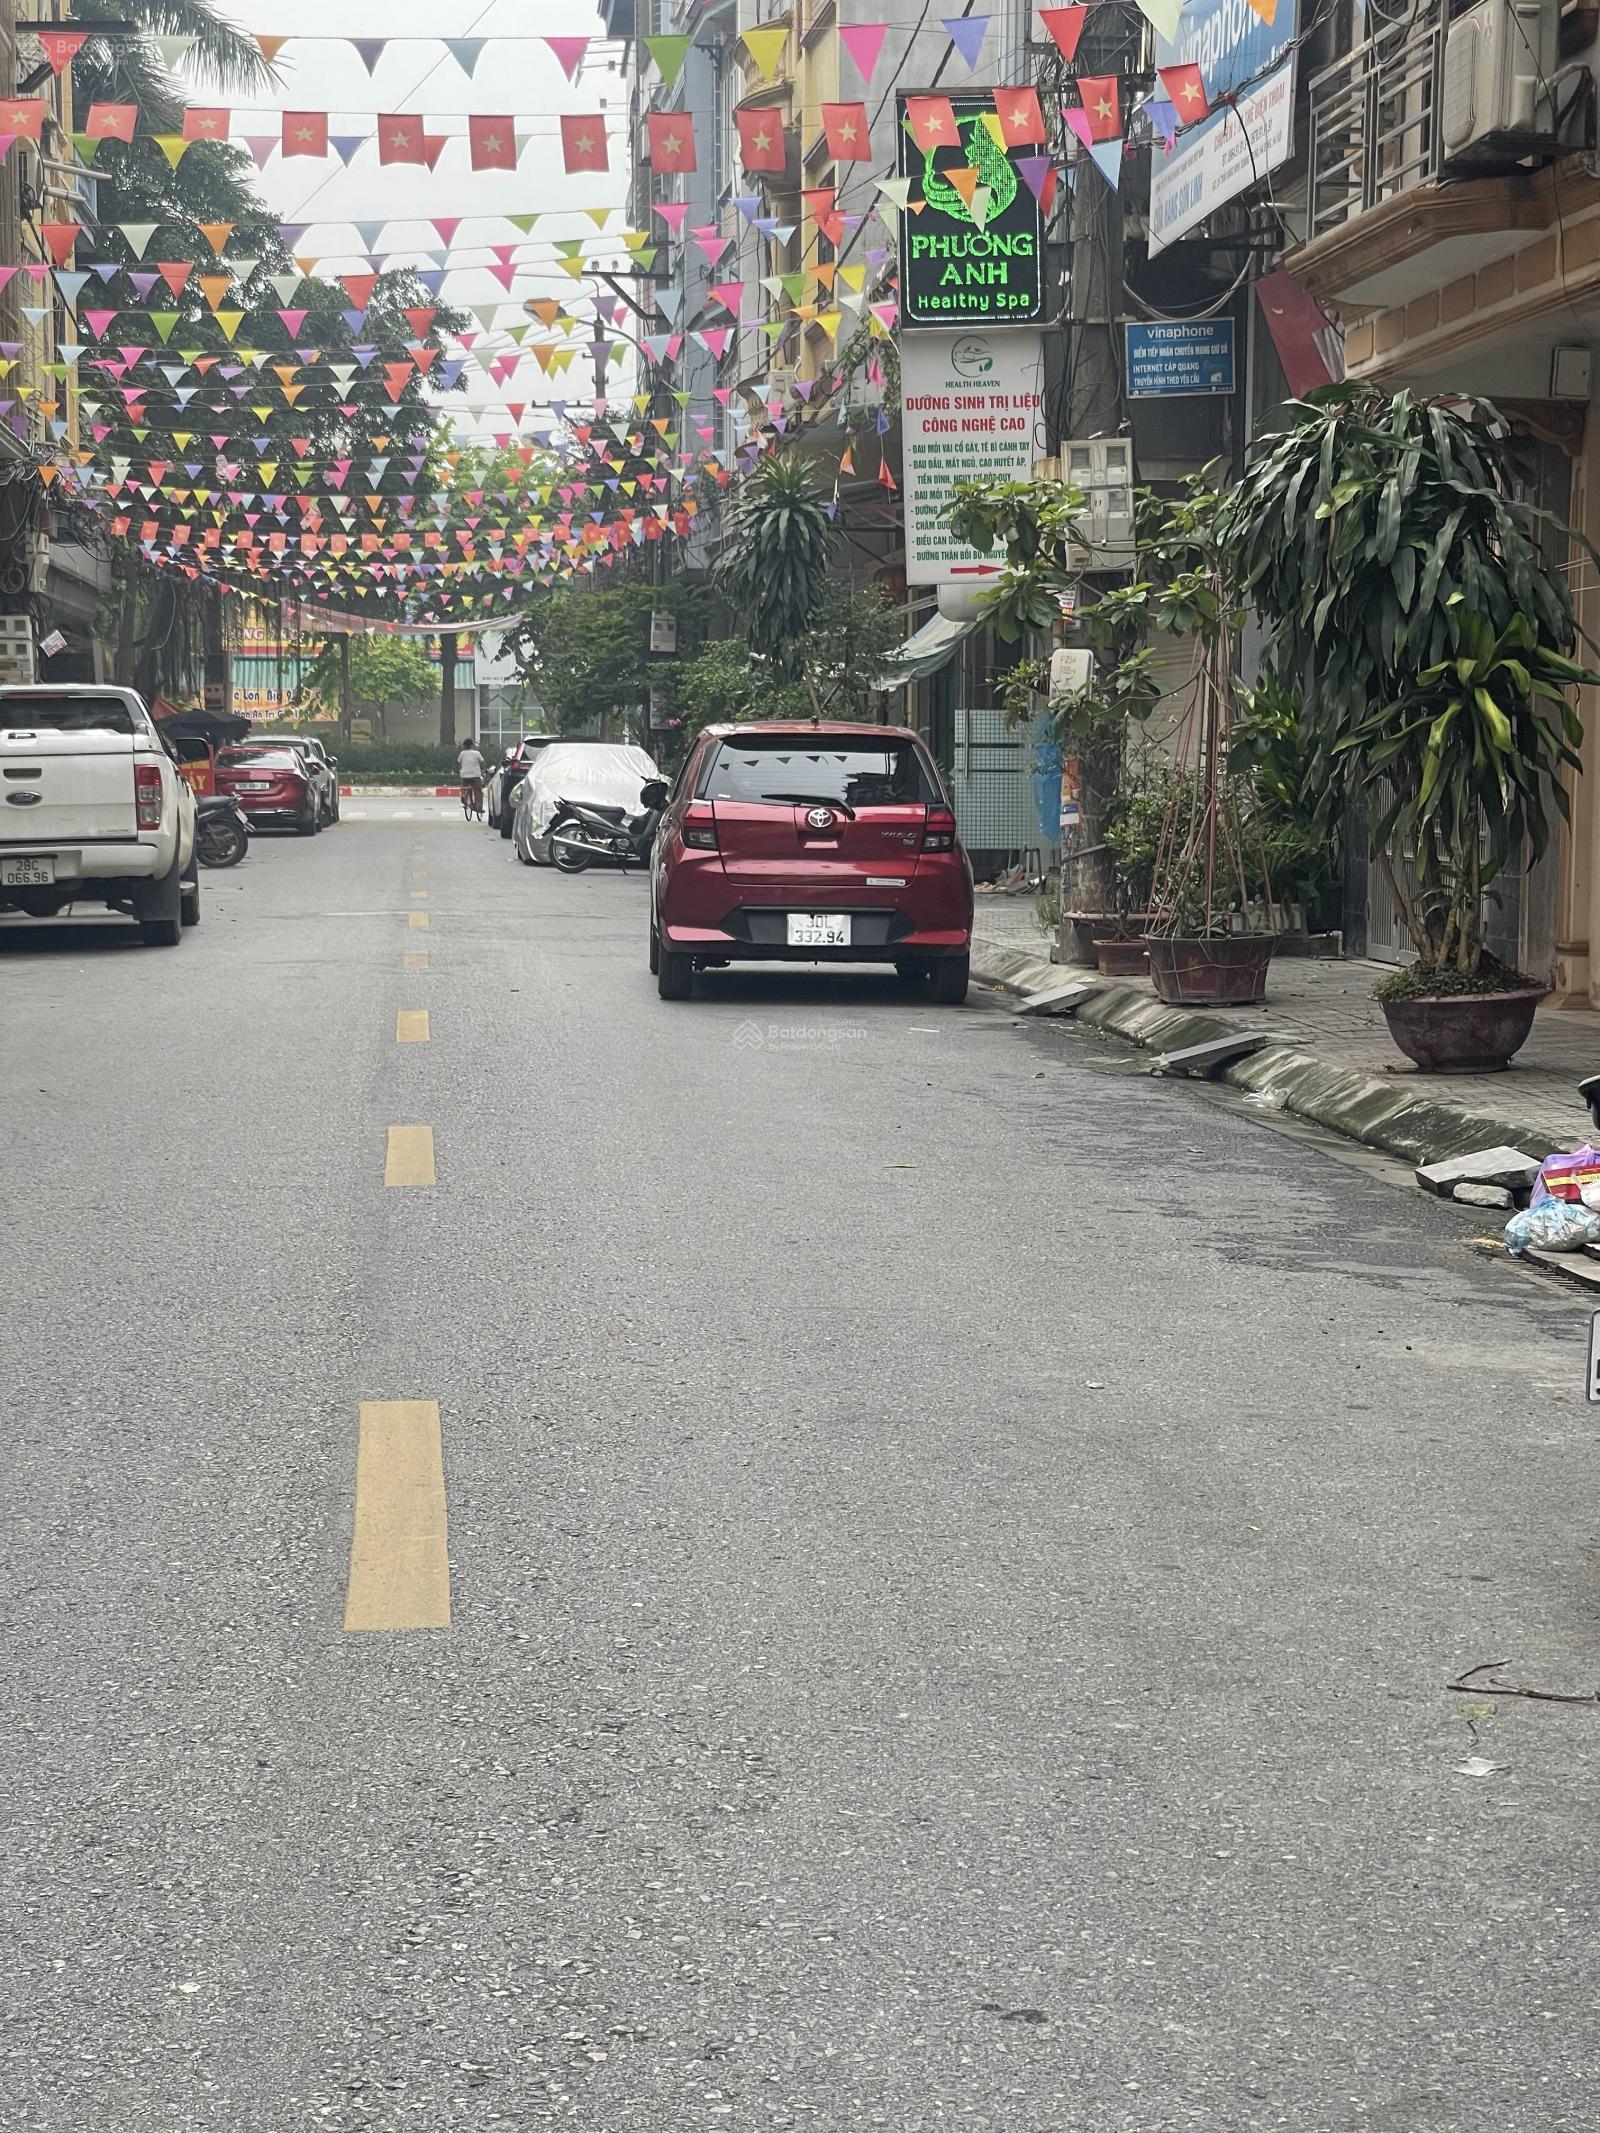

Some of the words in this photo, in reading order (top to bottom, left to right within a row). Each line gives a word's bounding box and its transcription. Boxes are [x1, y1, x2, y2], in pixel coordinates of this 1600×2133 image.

[912, 231, 1033, 259] PHƯƠNG
[940, 262, 1008, 285] ANH
[918, 293, 989, 310] Healthy
[996, 293, 1030, 310] Spa
[1147, 326, 1214, 339] vinaphone
[1133, 364, 1163, 374] INTERNET
[1177, 362, 1200, 372] QUANG
[906, 394, 949, 411] DƯỠNG
[954, 396, 985, 410] SINH
[988, 396, 1009, 411] TRỊ
[1013, 392, 1040, 411] LIỆU
[922, 417, 957, 433] CÔNG
[961, 416, 996, 434] NGHỆ
[1000, 418, 1025, 431] CAO
[942, 443, 952, 453] VAI
[1019, 441, 1030, 451] TAY
[979, 458, 992, 467] CAO
[933, 536, 947, 546] CAN
[7, 872, 48, 884] 066.96
[794, 930, 845, 944] 332.94
